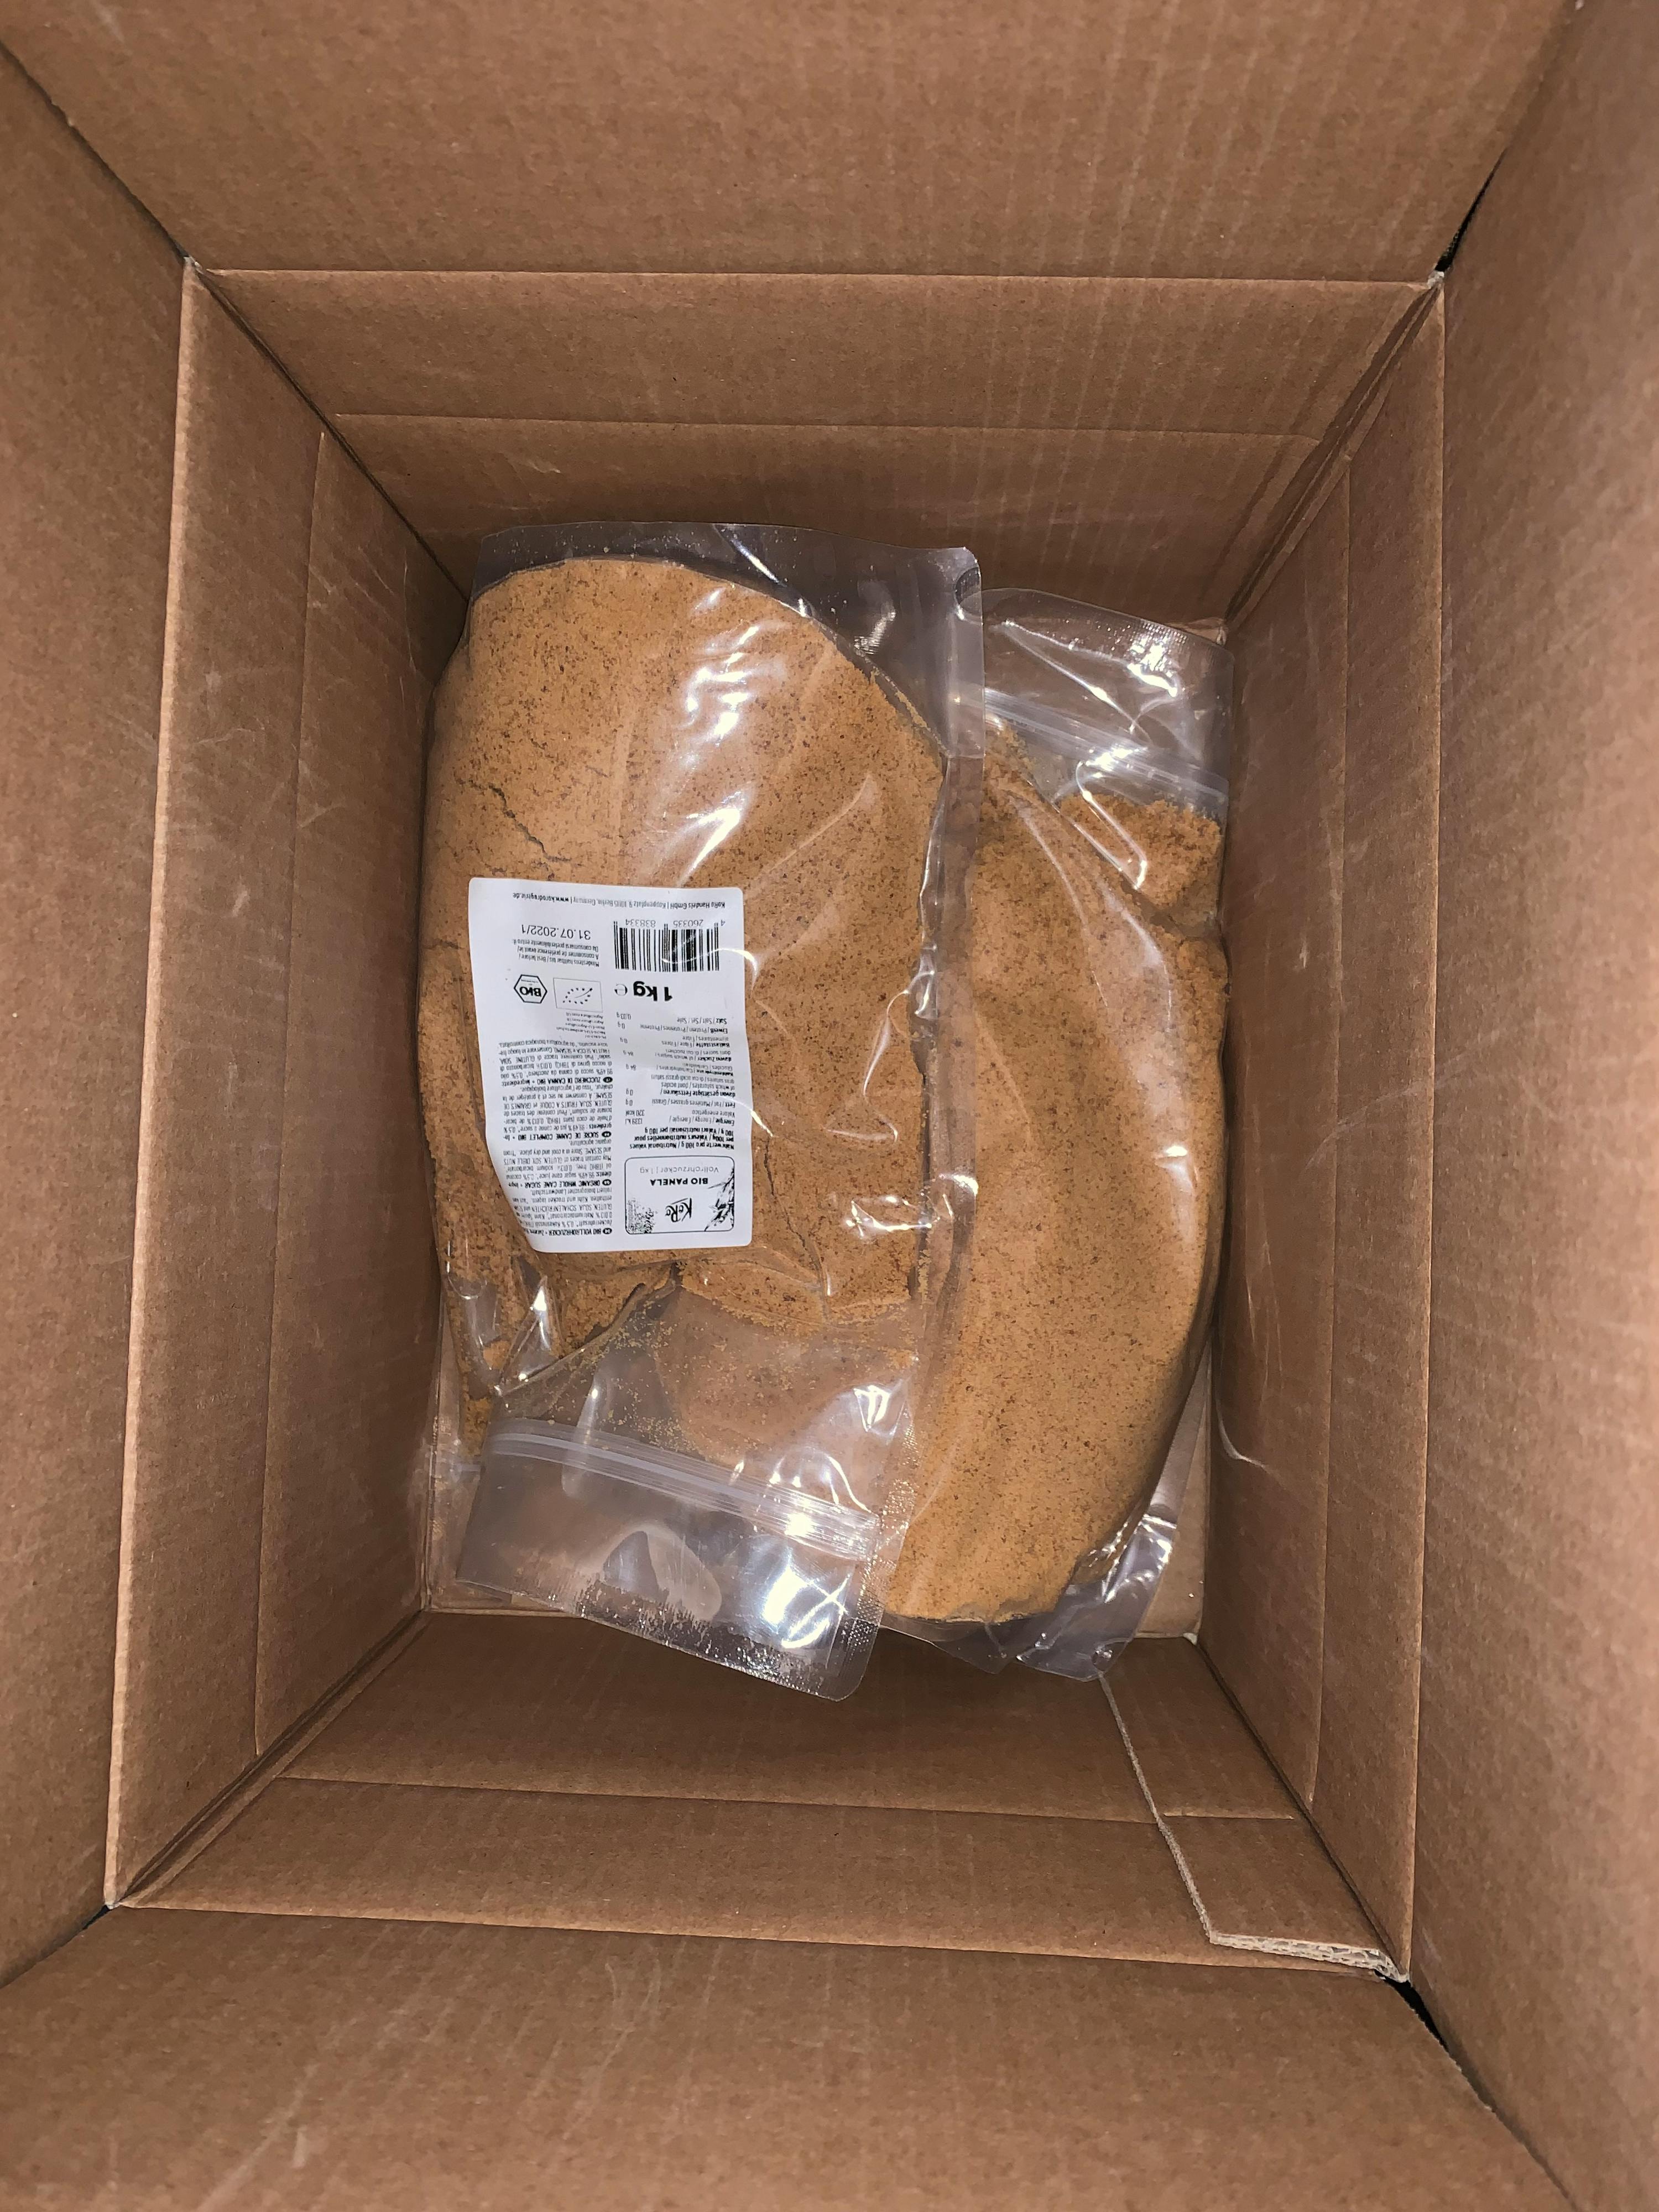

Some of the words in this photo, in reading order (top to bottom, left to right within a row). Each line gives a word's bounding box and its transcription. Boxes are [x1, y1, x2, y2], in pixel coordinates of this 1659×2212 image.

[625, 919, 656, 928] 838334
[673, 919, 703, 928] 260335
[521, 924, 591, 940] 31.07.2022/1
[519, 986, 541, 997] BIO
[633, 981, 658, 1001] kg
[664, 987, 673, 1001] 1
[665, 1198, 692, 1222] KoRo
